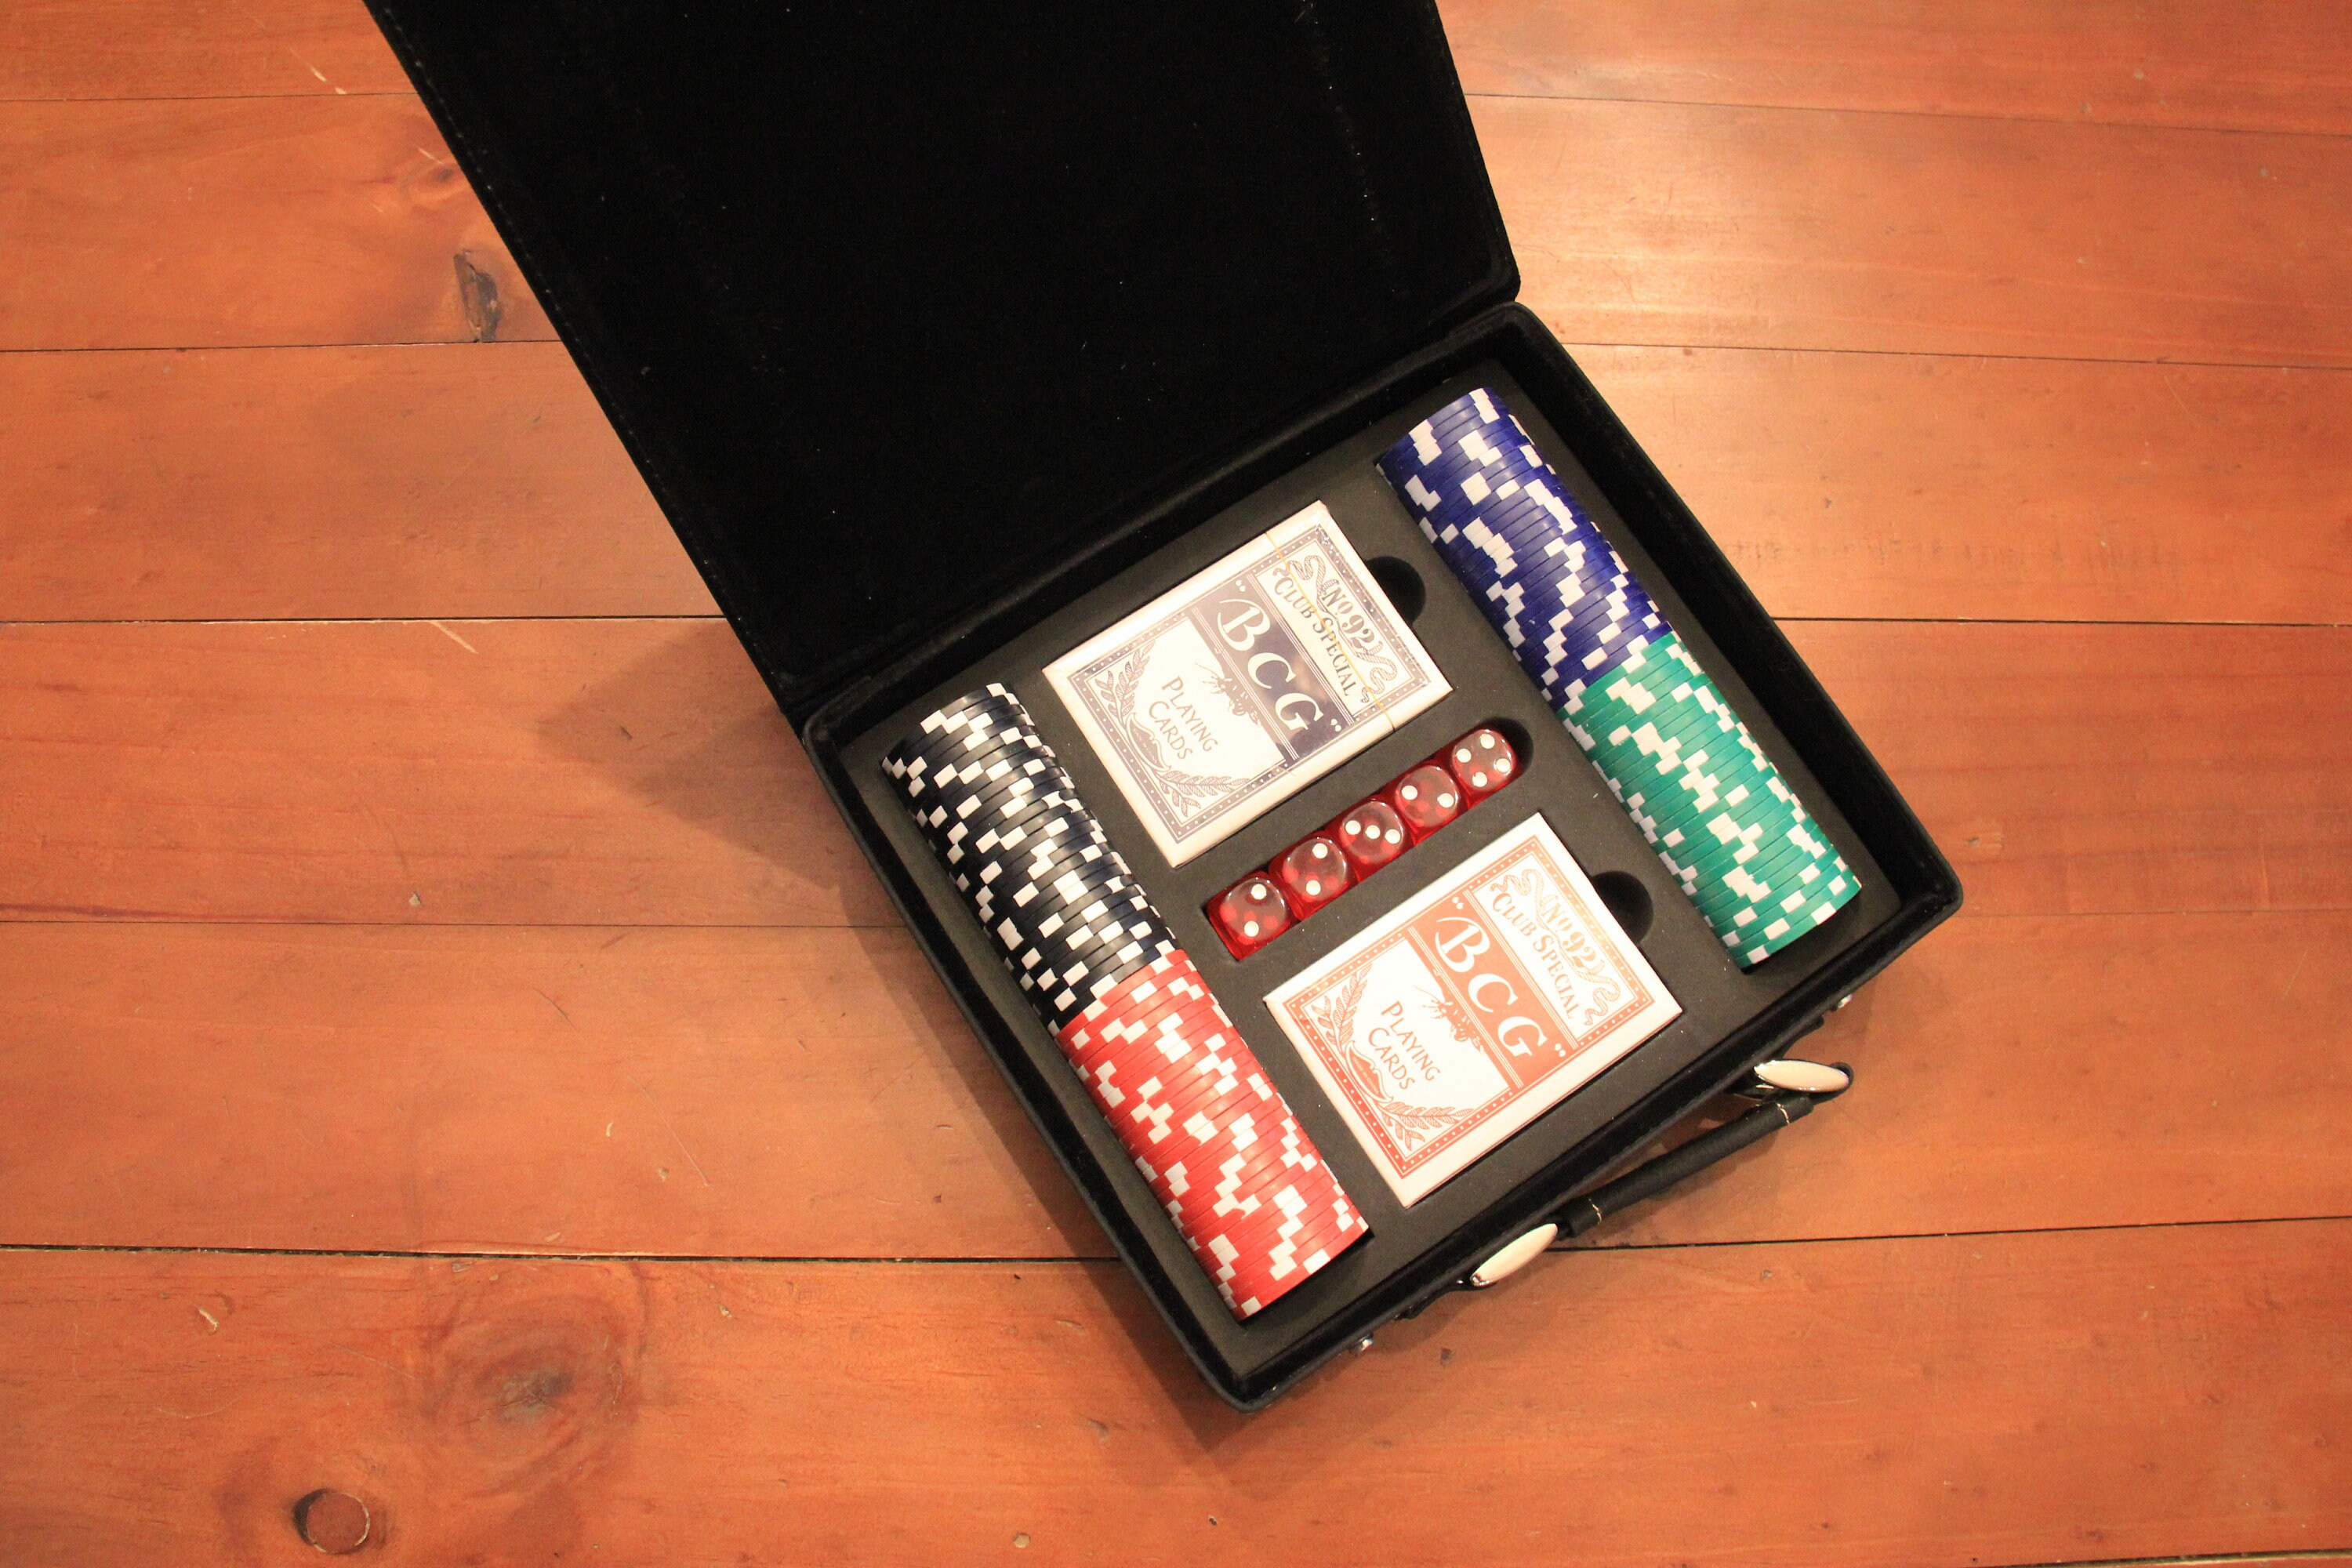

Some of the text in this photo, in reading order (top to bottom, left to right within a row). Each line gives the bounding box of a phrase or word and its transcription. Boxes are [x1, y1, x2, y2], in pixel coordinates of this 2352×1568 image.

[1274, 577, 1356, 697] CLUB SPECIAL
[1149, 700, 1192, 760] CARDS
[1161, 676, 1218, 753] PLAYING
[1493, 892, 1580, 1019] CLUB SPECIAL
[1369, 1027, 1415, 1090] CARDS
[1381, 1000, 1440, 1082] PLAYING
